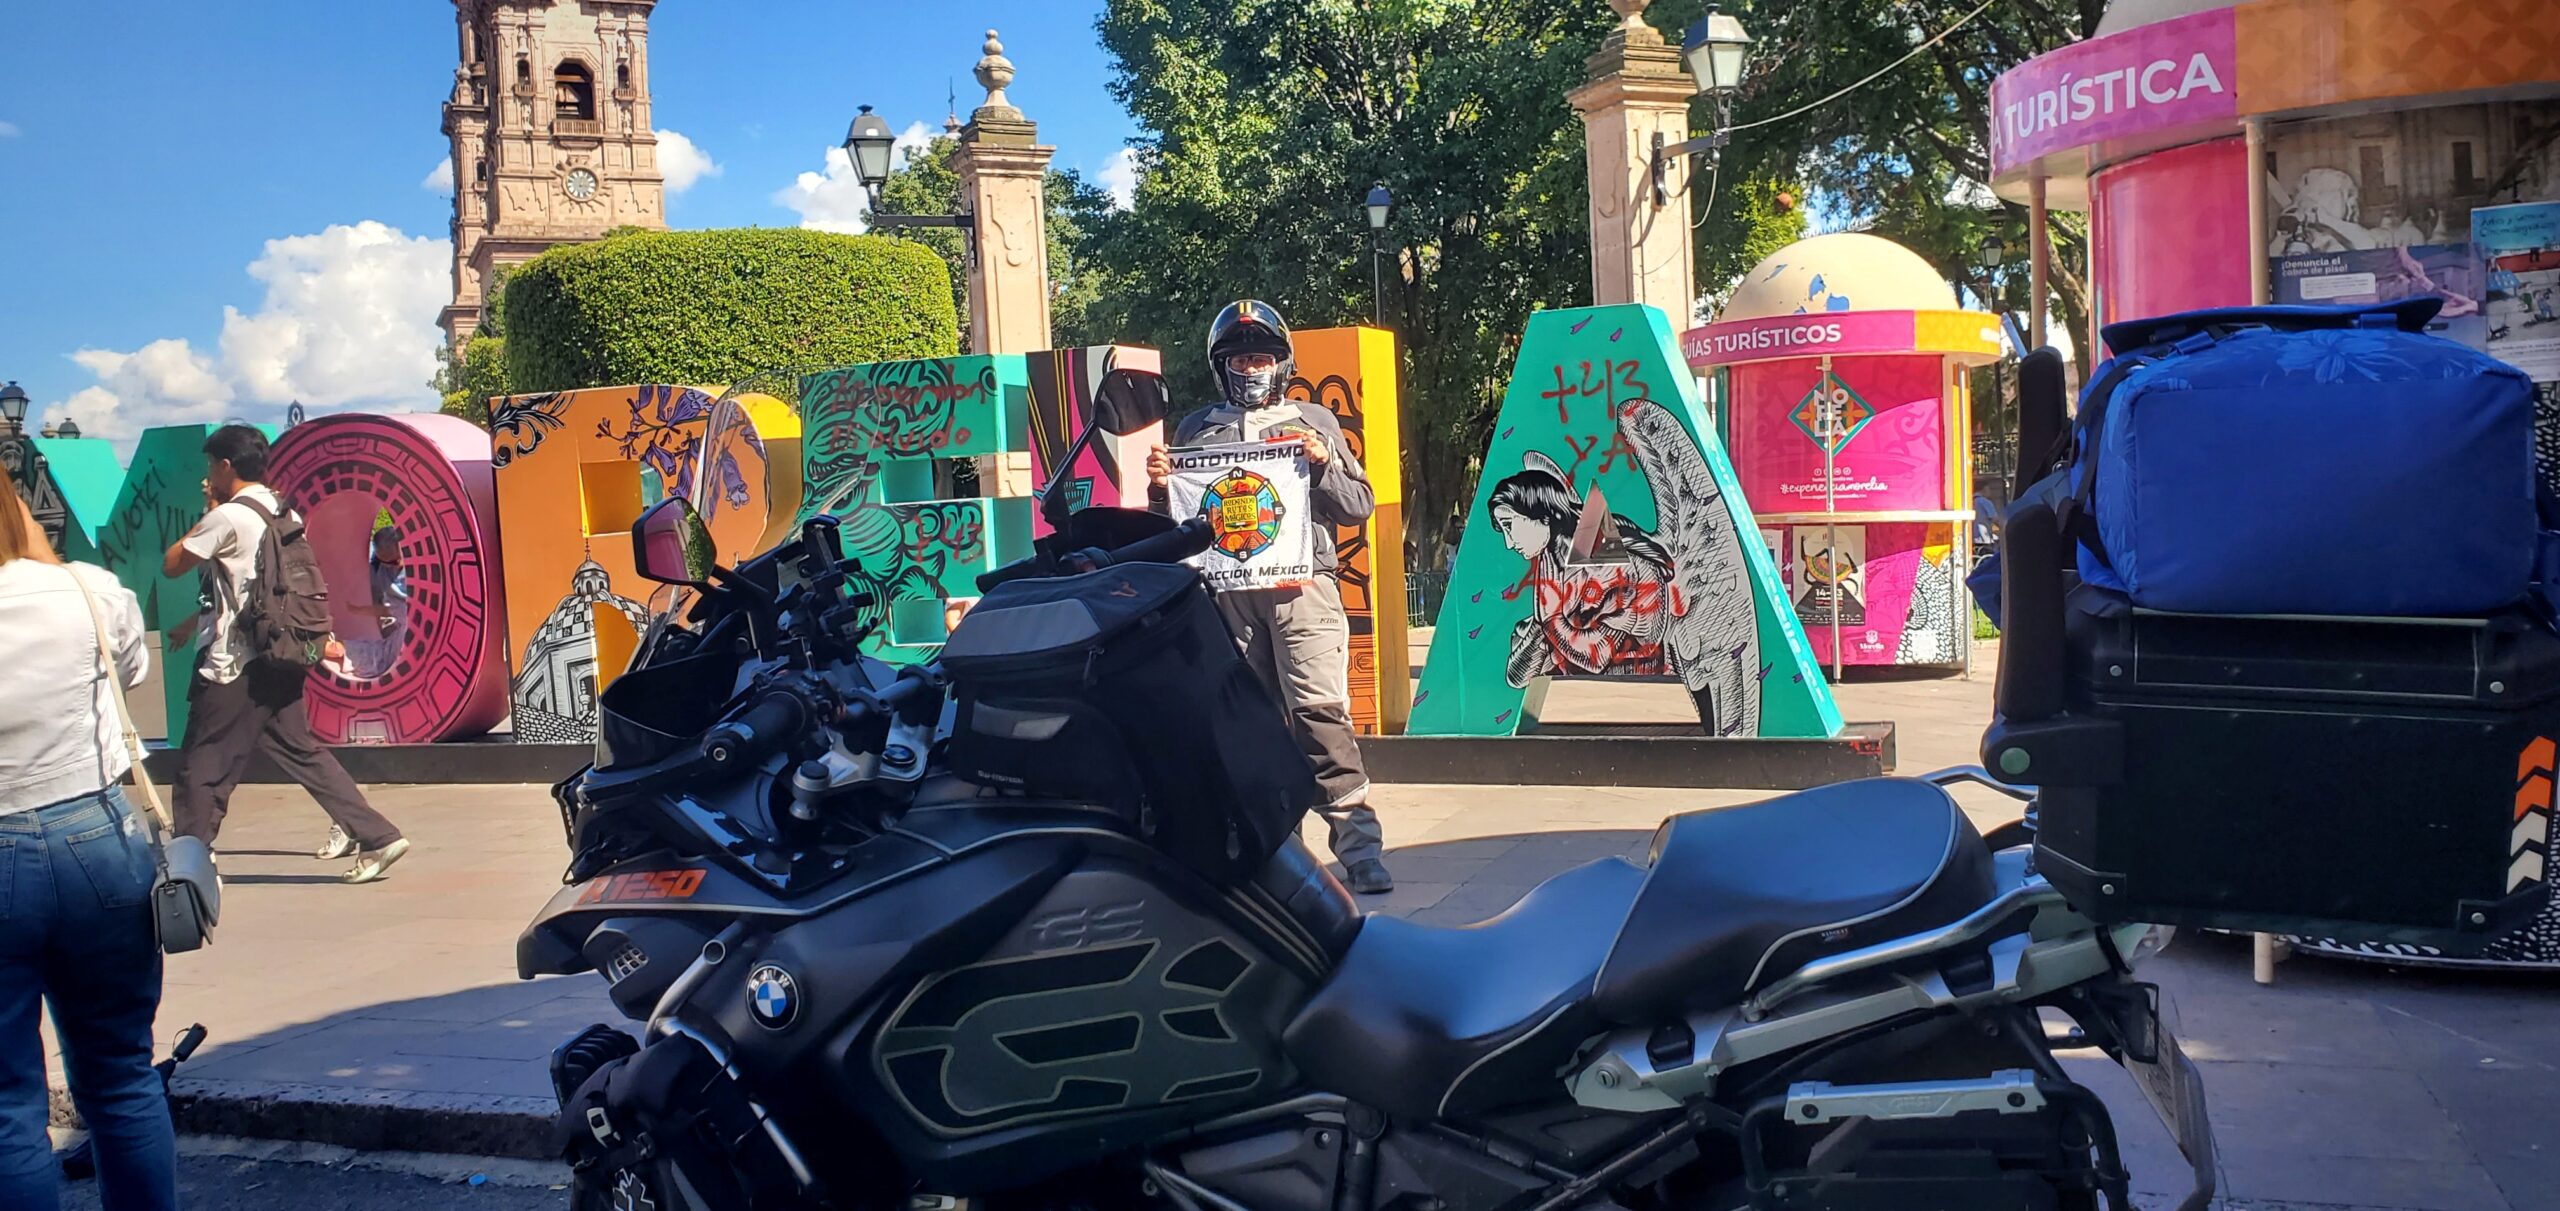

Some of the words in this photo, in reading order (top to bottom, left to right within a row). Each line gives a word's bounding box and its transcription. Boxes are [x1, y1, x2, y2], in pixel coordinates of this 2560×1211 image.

[2004, 52, 2224, 144] TURÍSTICA
[2331, 256, 2341, 264] el
[1682, 337, 1711, 360] UÍAS
[1715, 324, 1842, 352] TURÍSTICOS
[1169, 445, 1305, 470] MOTOTURISMO
[1565, 431, 1638, 489] YA
[1232, 469, 1242, 478] N
[1275, 507, 1284, 515] E
[1239, 551, 1248, 559] S
[1258, 563, 1309, 577] MÉXICO
[750, 968, 792, 992] BMW
